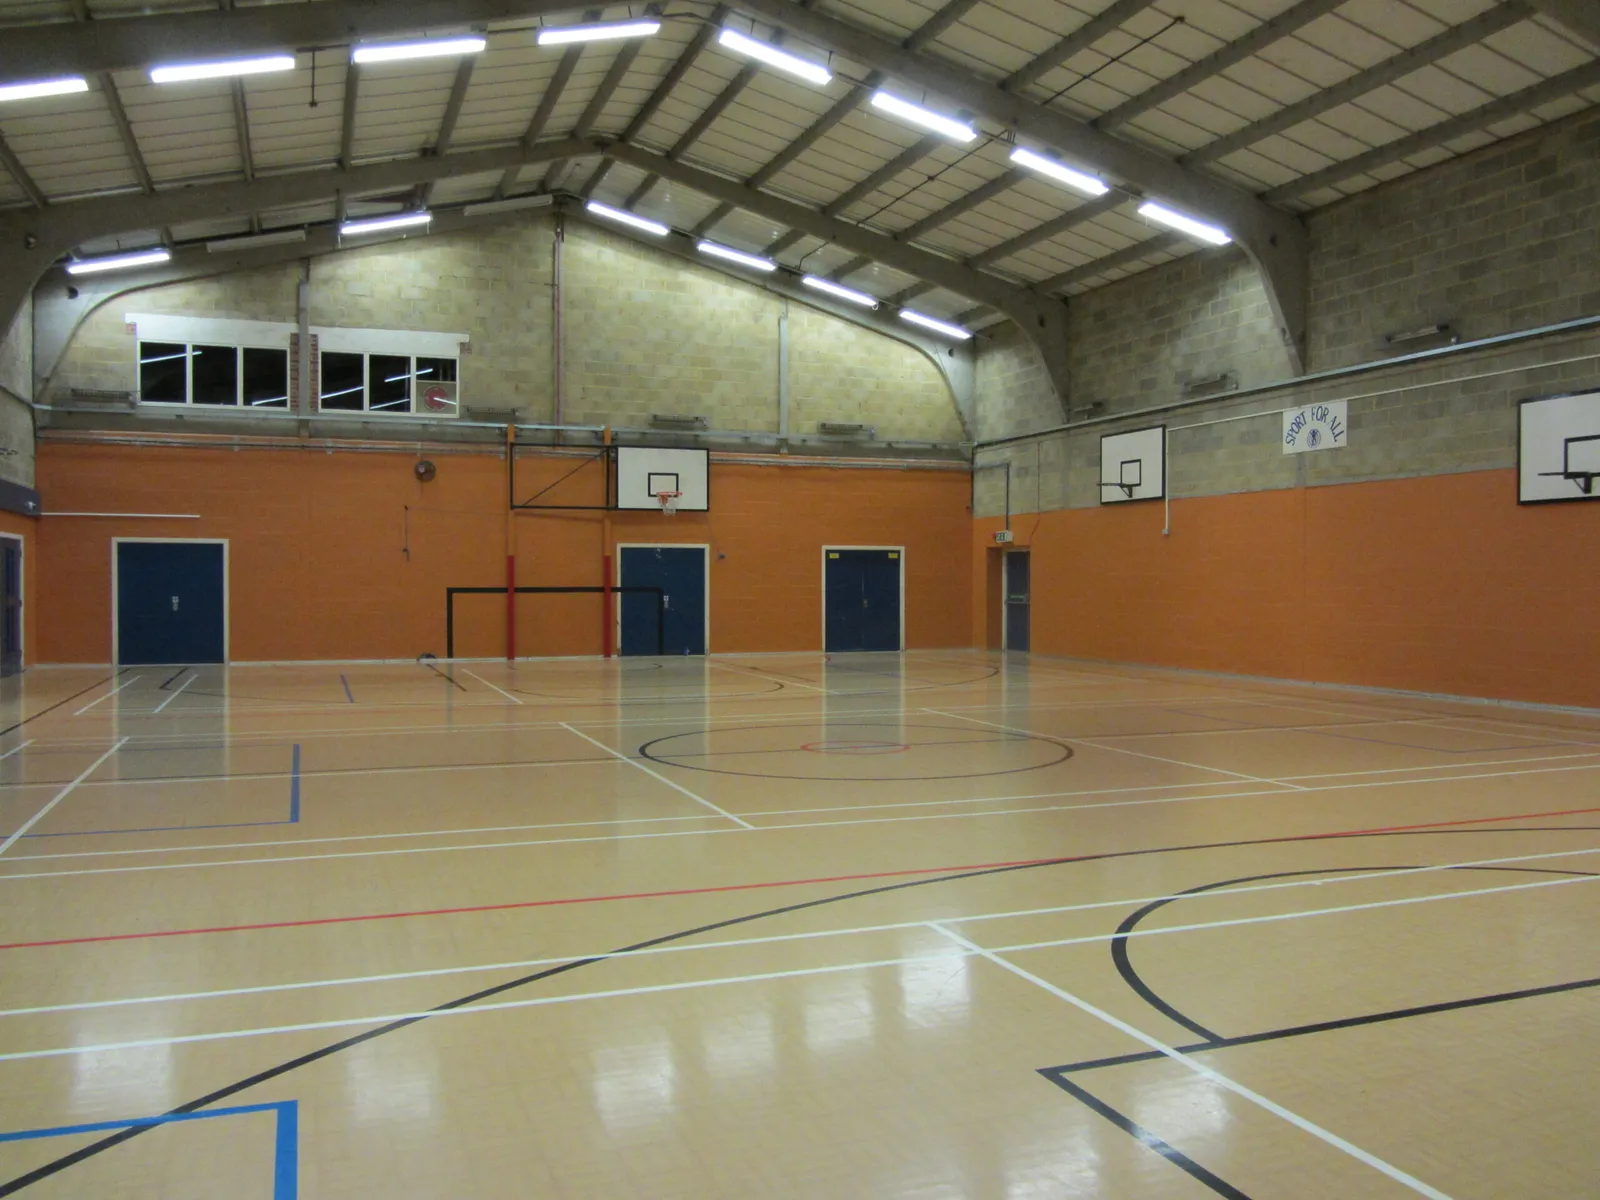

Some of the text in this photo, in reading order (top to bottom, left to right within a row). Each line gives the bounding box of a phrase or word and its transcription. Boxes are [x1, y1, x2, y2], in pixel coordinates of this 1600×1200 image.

[1285, 405, 1345, 446] SPORT FOR ALL
